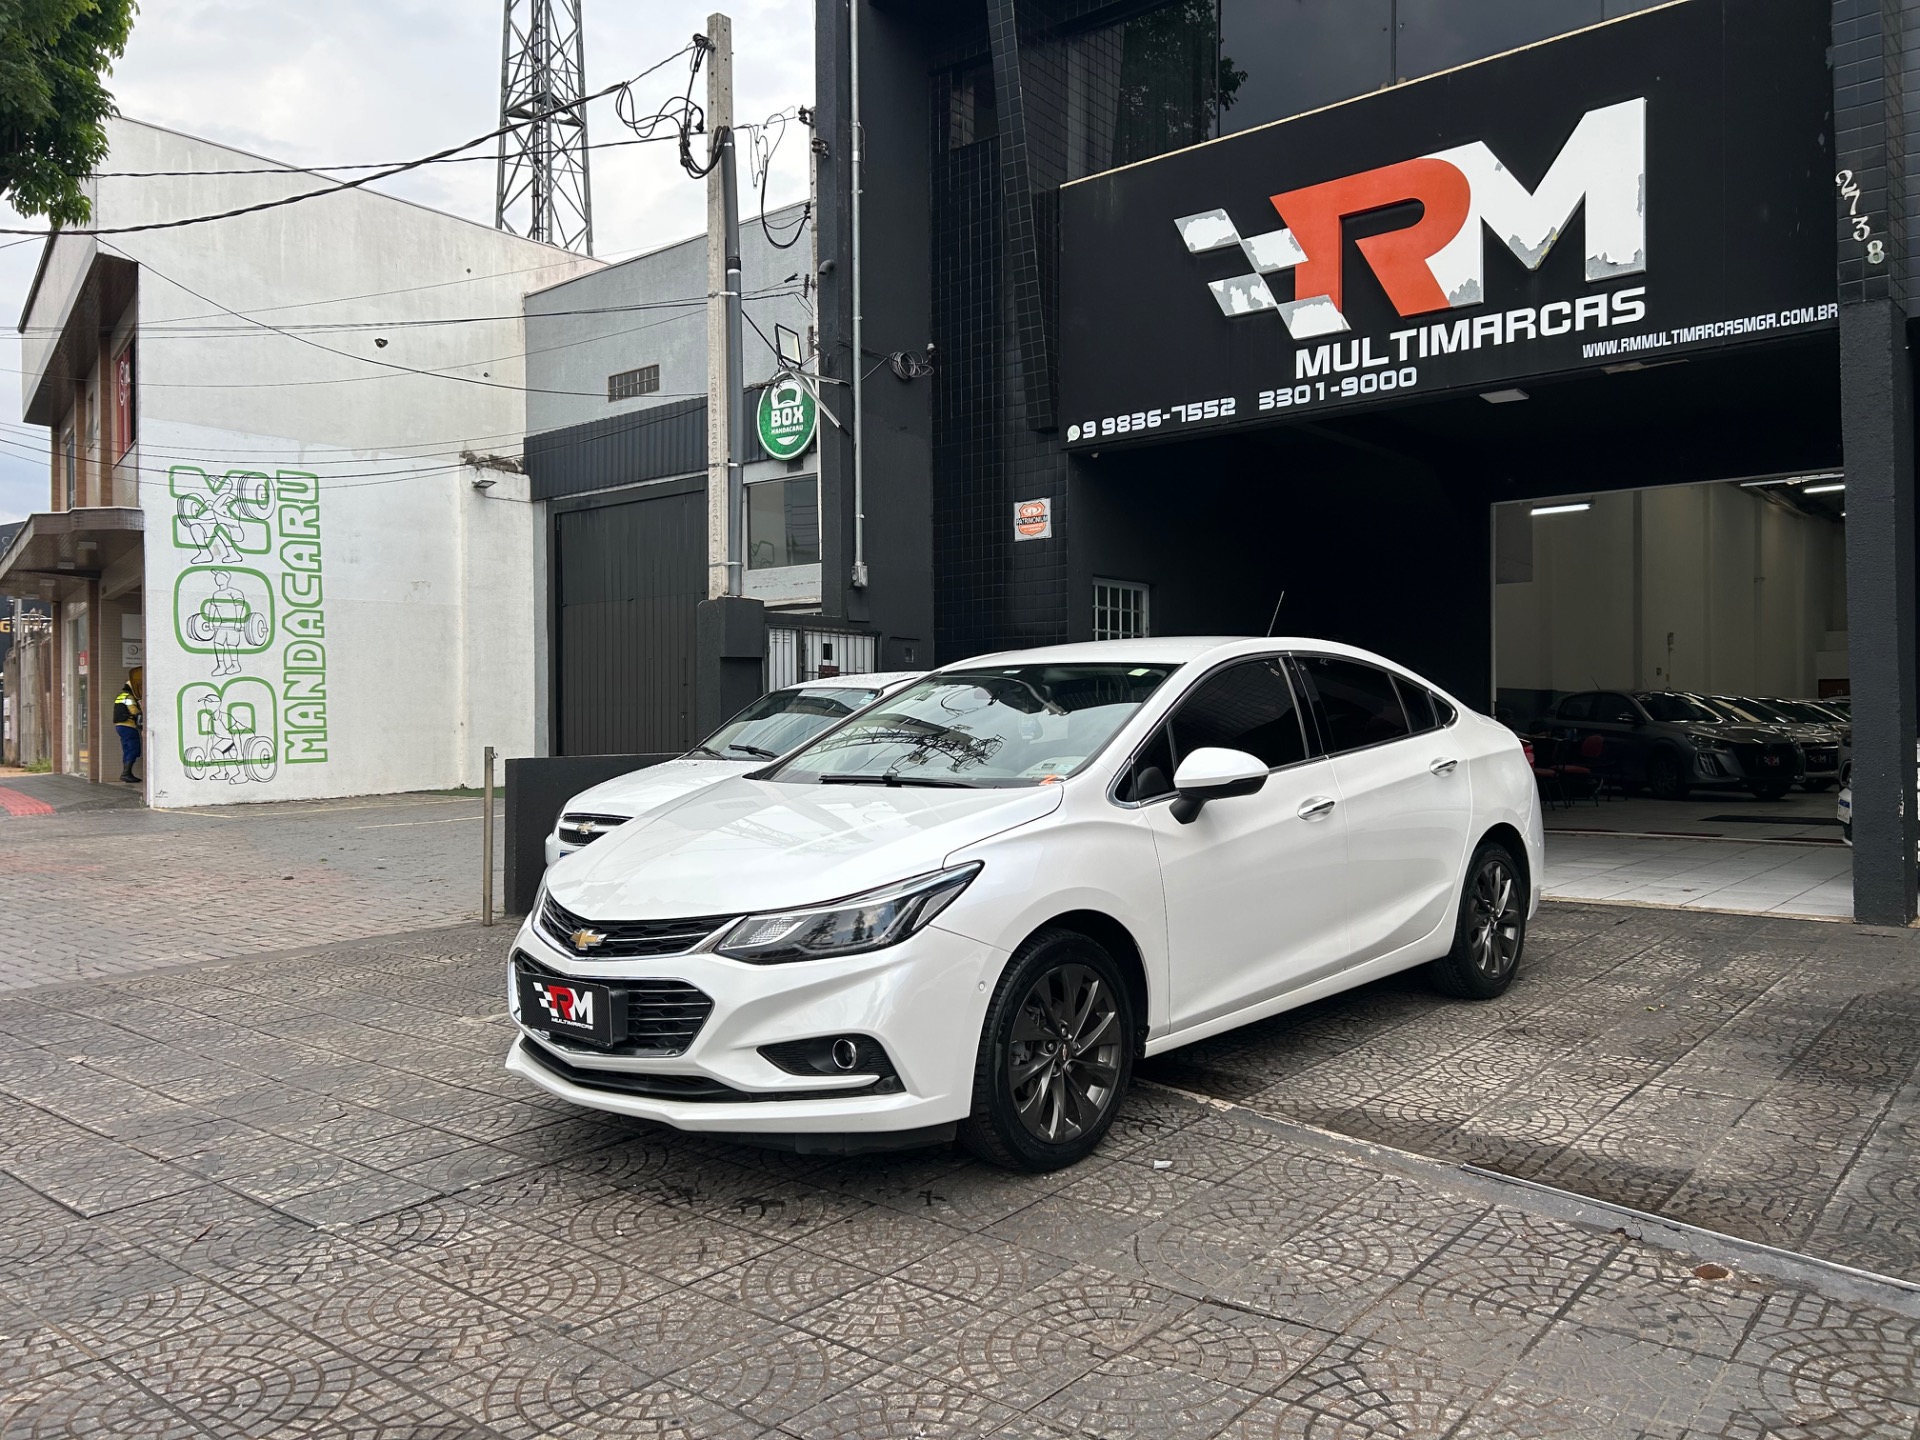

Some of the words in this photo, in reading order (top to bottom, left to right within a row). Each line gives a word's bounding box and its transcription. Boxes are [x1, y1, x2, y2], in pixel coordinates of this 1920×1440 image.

[1268, 97, 1648, 328] RM
[1835, 169, 1885, 265] 2738
[1295, 286, 1646, 379] MULTIMARCAS
[1582, 302, 1839, 359] WWW.RMMULTIMARCASMGA.COM.BR
[770, 405, 804, 428] BOX
[1082, 420, 1096, 439] 9
[1101, 397, 1236, 436] 9836-7552
[1258, 366, 1417, 411] 3301-9000
[276, 469, 329, 765] MANDACARU
[547, 985, 593, 1024] RM
